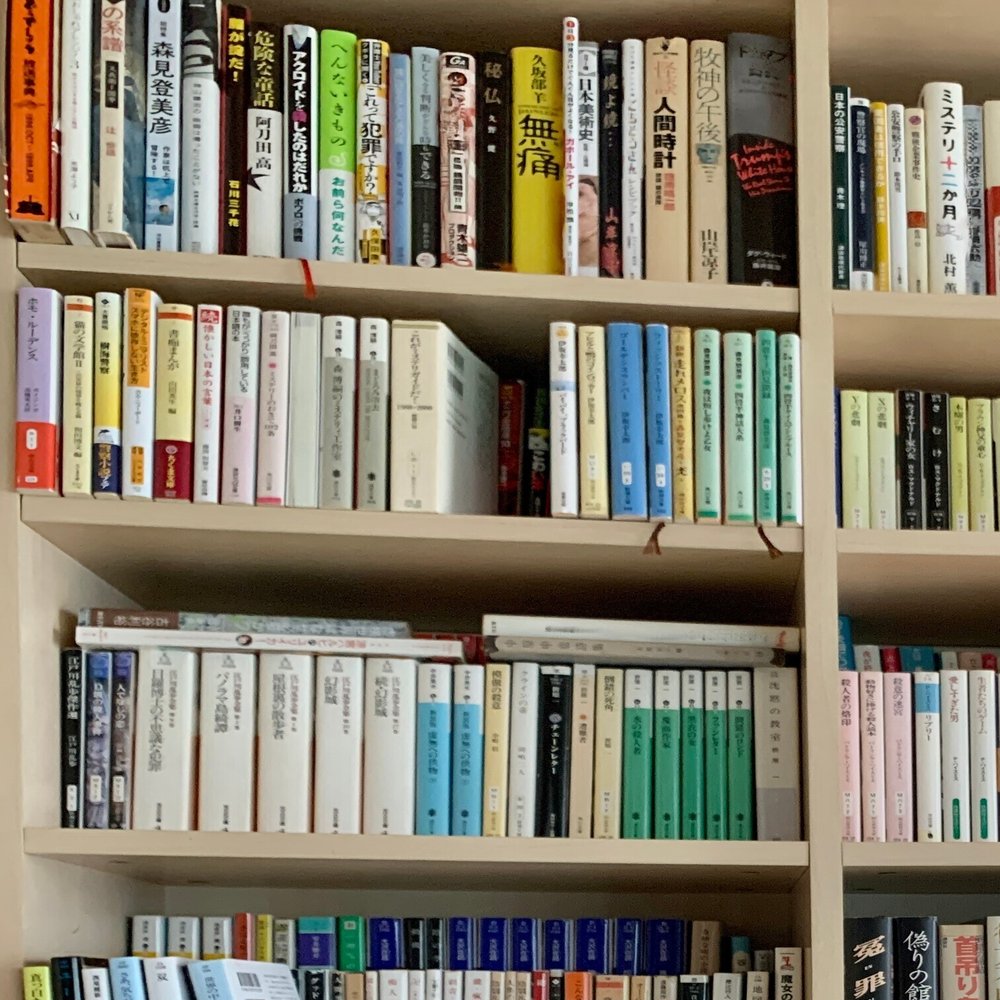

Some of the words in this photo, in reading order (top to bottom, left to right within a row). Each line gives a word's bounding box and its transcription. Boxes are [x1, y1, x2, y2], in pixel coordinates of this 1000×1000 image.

[150, 42, 175, 134] 森見登美彦
[253, 30, 275, 109] 危険な童話
[331, 44, 348, 147] へんないきもの
[694, 47, 722, 143] 牧神の午後
[579, 79, 594, 141] 日本美術史
[653, 96, 676, 168] 人間時計
[834, 92, 846, 153] 日本の公安警察
[517, 115, 560, 180] 無痛
[940, 89, 958, 220] ミステリ十二か月
[332, 177, 345, 255] お前ら何なんだ
[27, 298, 38, 361] ホモ・ルーデンス
[100, 342, 110, 374] 樹海警察
[703, 388, 712, 452] 夜は短し歩けよ乙女
[734, 392, 744, 441] 四畳半神話大系
[932, 405, 942, 458] さむけ
[949, 676, 959, 723] 愛しすぎた男
[551, 724, 562, 774] チェーンレター
